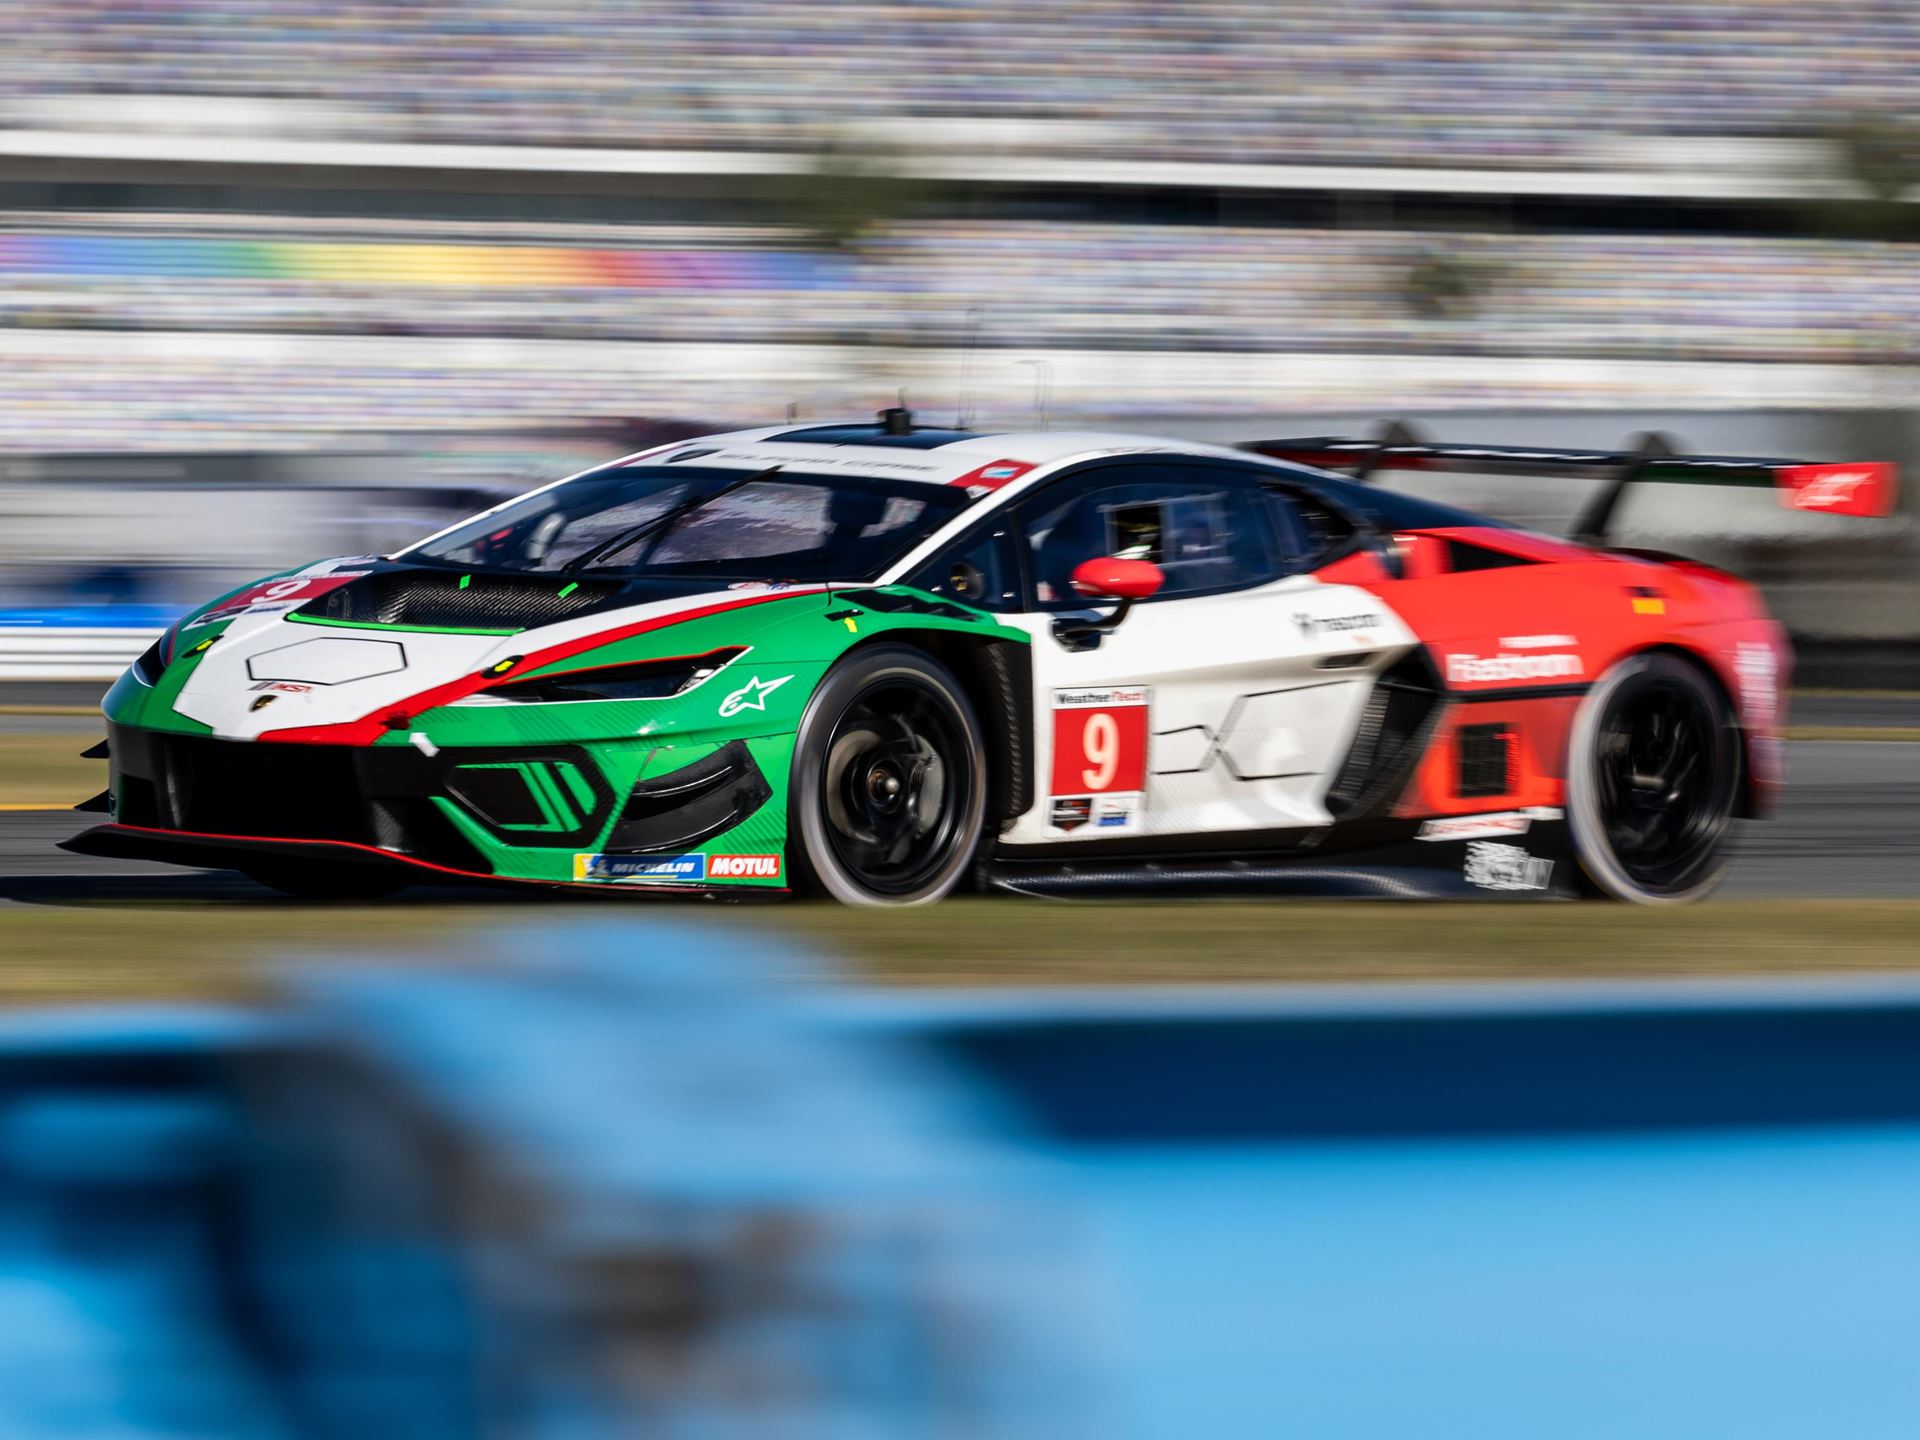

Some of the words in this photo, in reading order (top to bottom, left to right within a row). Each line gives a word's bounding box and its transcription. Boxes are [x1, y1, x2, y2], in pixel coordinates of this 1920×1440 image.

[251, 579, 312, 603] 9
[1081, 712, 1120, 790] 9
[611, 861, 696, 874] MICHELIN
[710, 857, 778, 876] MOTUL
